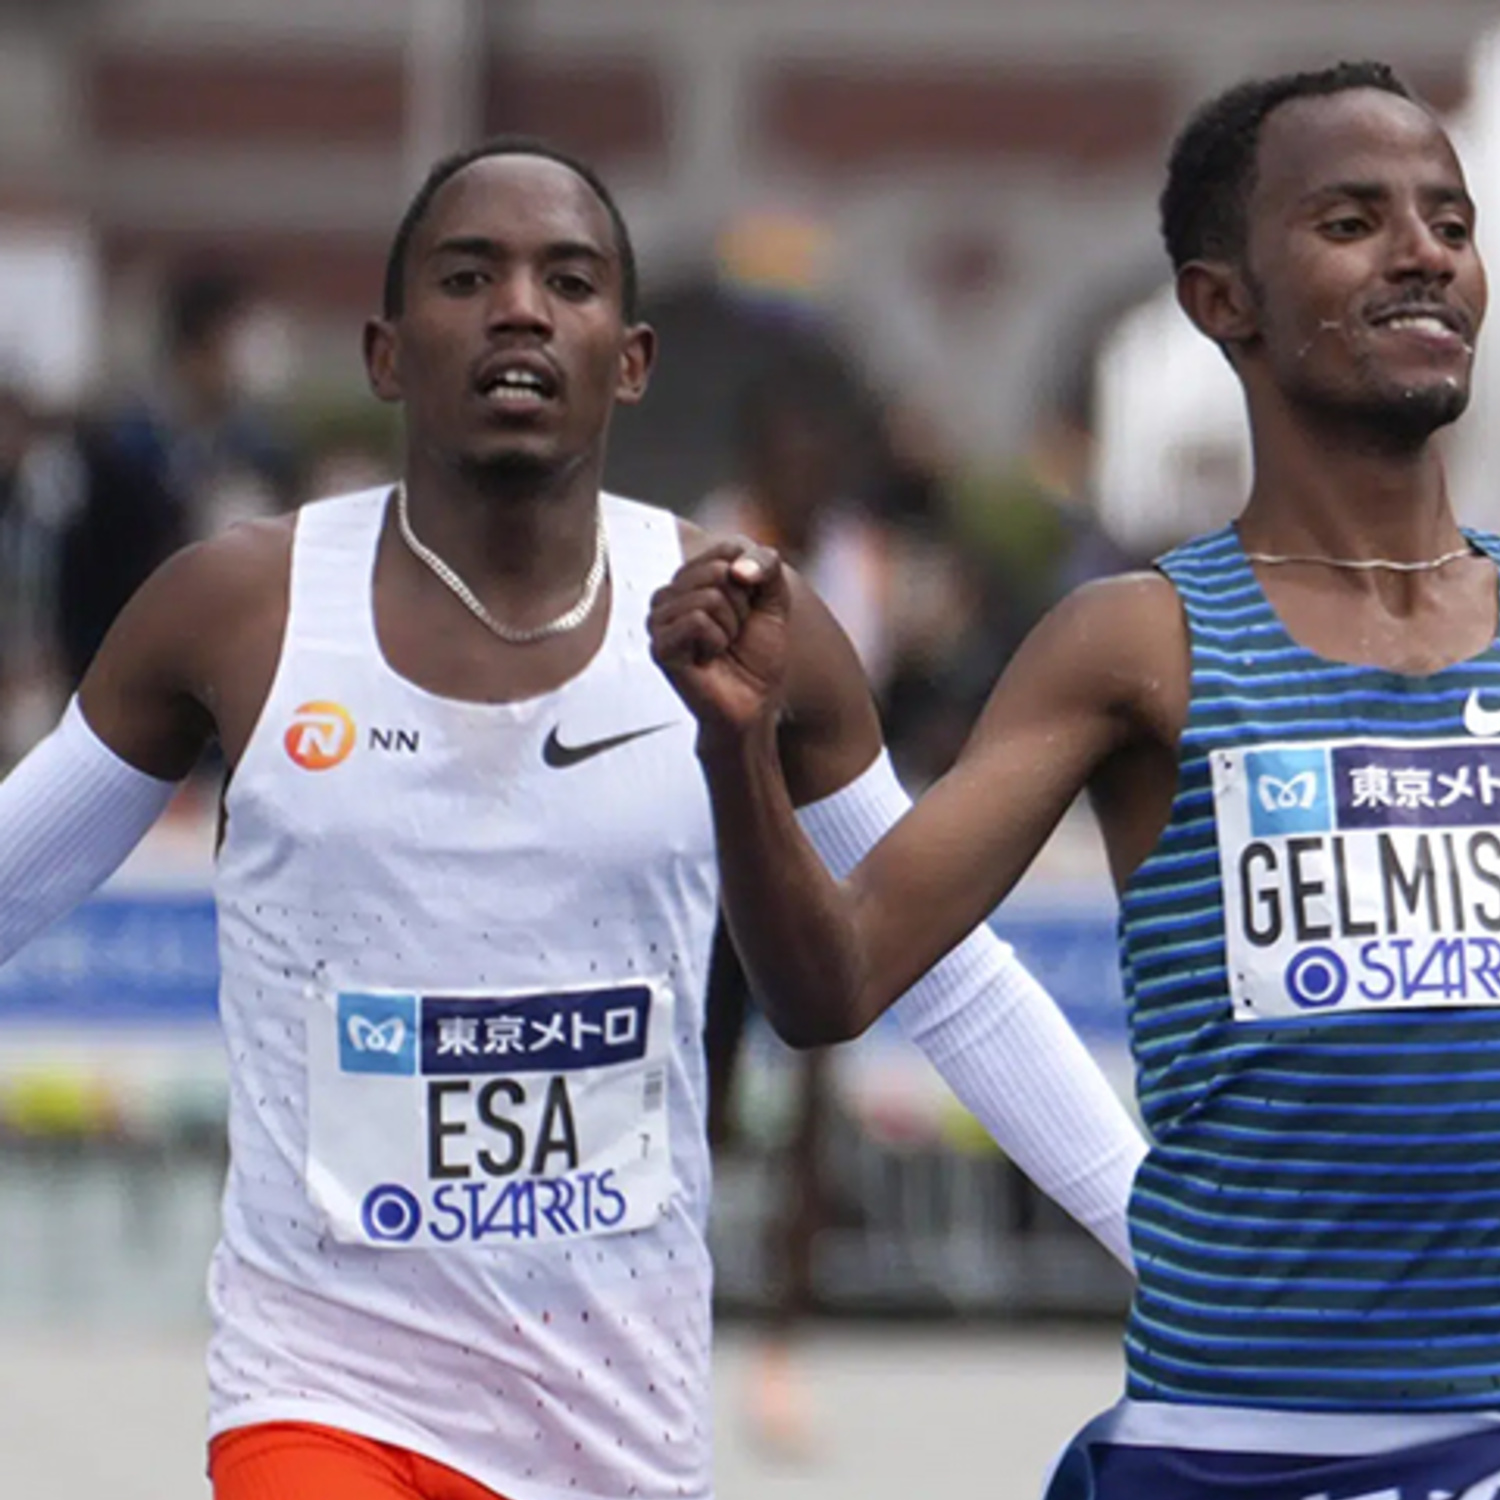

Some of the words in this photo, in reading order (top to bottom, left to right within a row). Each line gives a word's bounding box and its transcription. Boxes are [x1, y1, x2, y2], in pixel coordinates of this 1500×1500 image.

[368, 727, 420, 752] NN
[436, 1007, 638, 1056] 東京メトロ
[428, 1075, 580, 1179] ESA
[428, 1169, 627, 1242] STARTS
